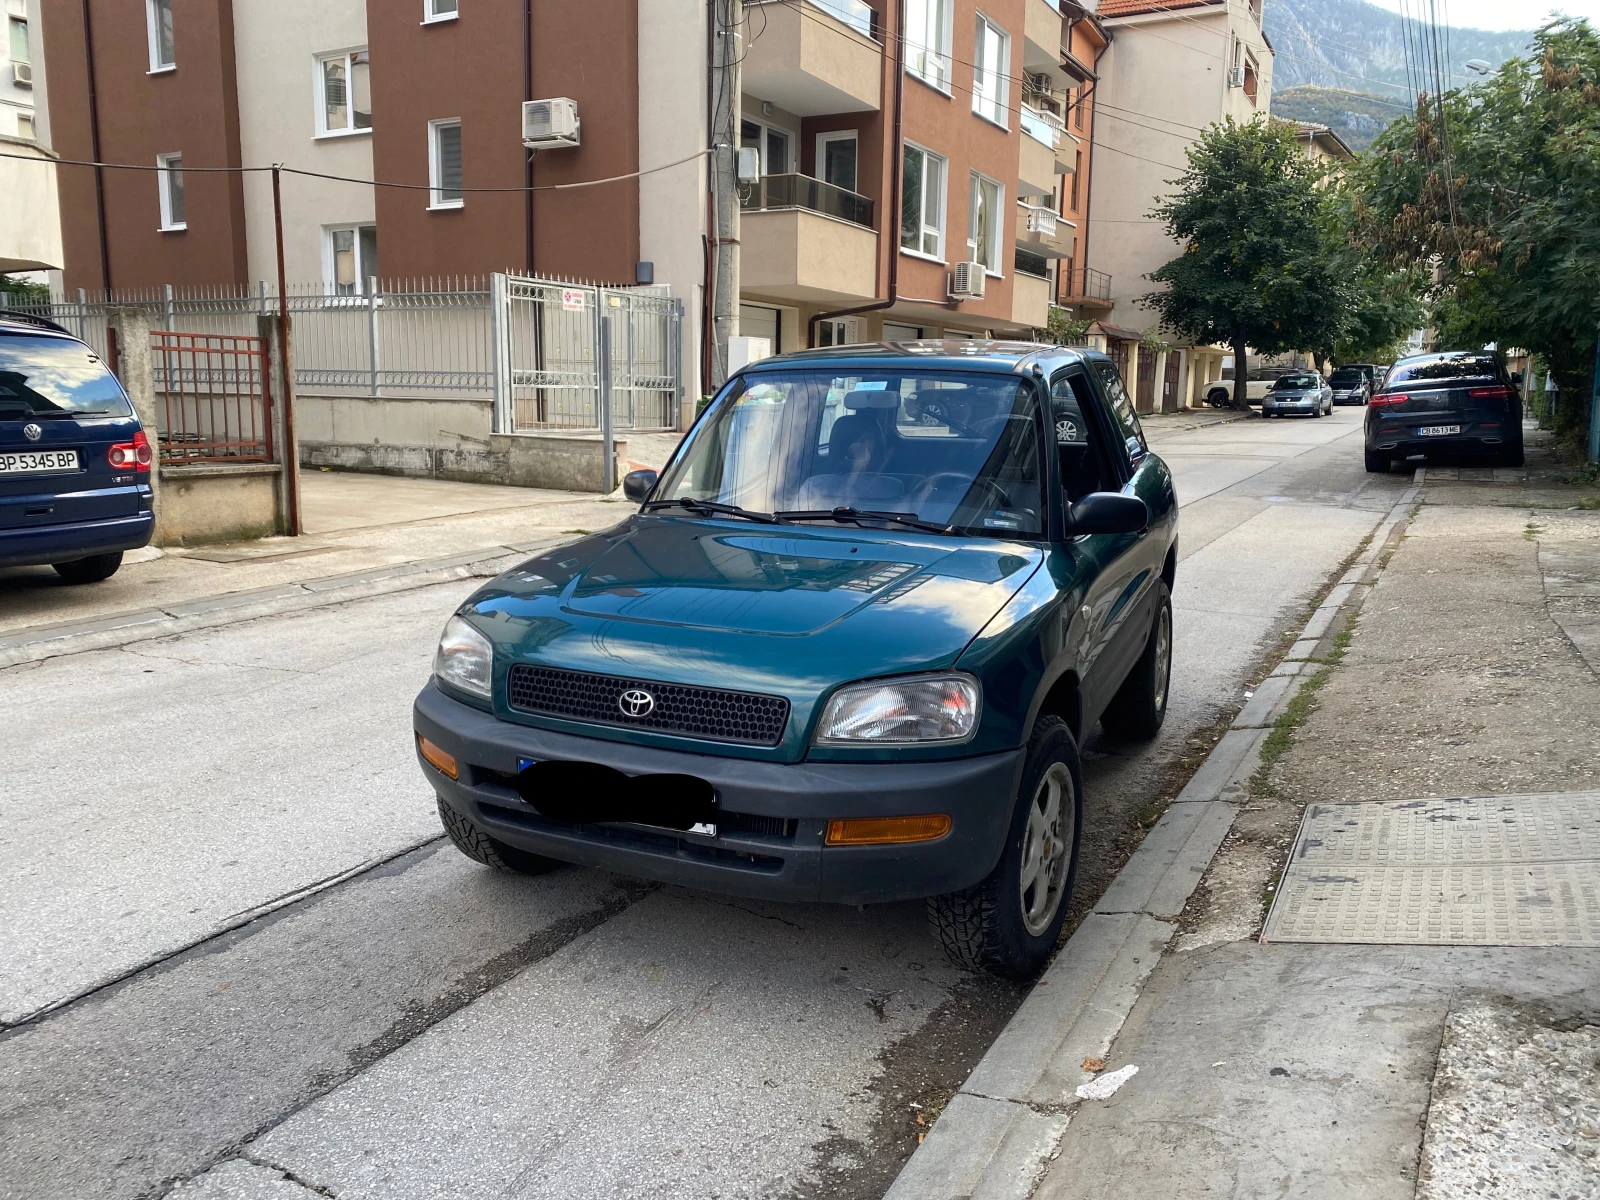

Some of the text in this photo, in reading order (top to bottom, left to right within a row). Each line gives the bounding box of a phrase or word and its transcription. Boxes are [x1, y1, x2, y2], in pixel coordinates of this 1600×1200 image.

[0, 453, 75, 470] BP 5345 BP
